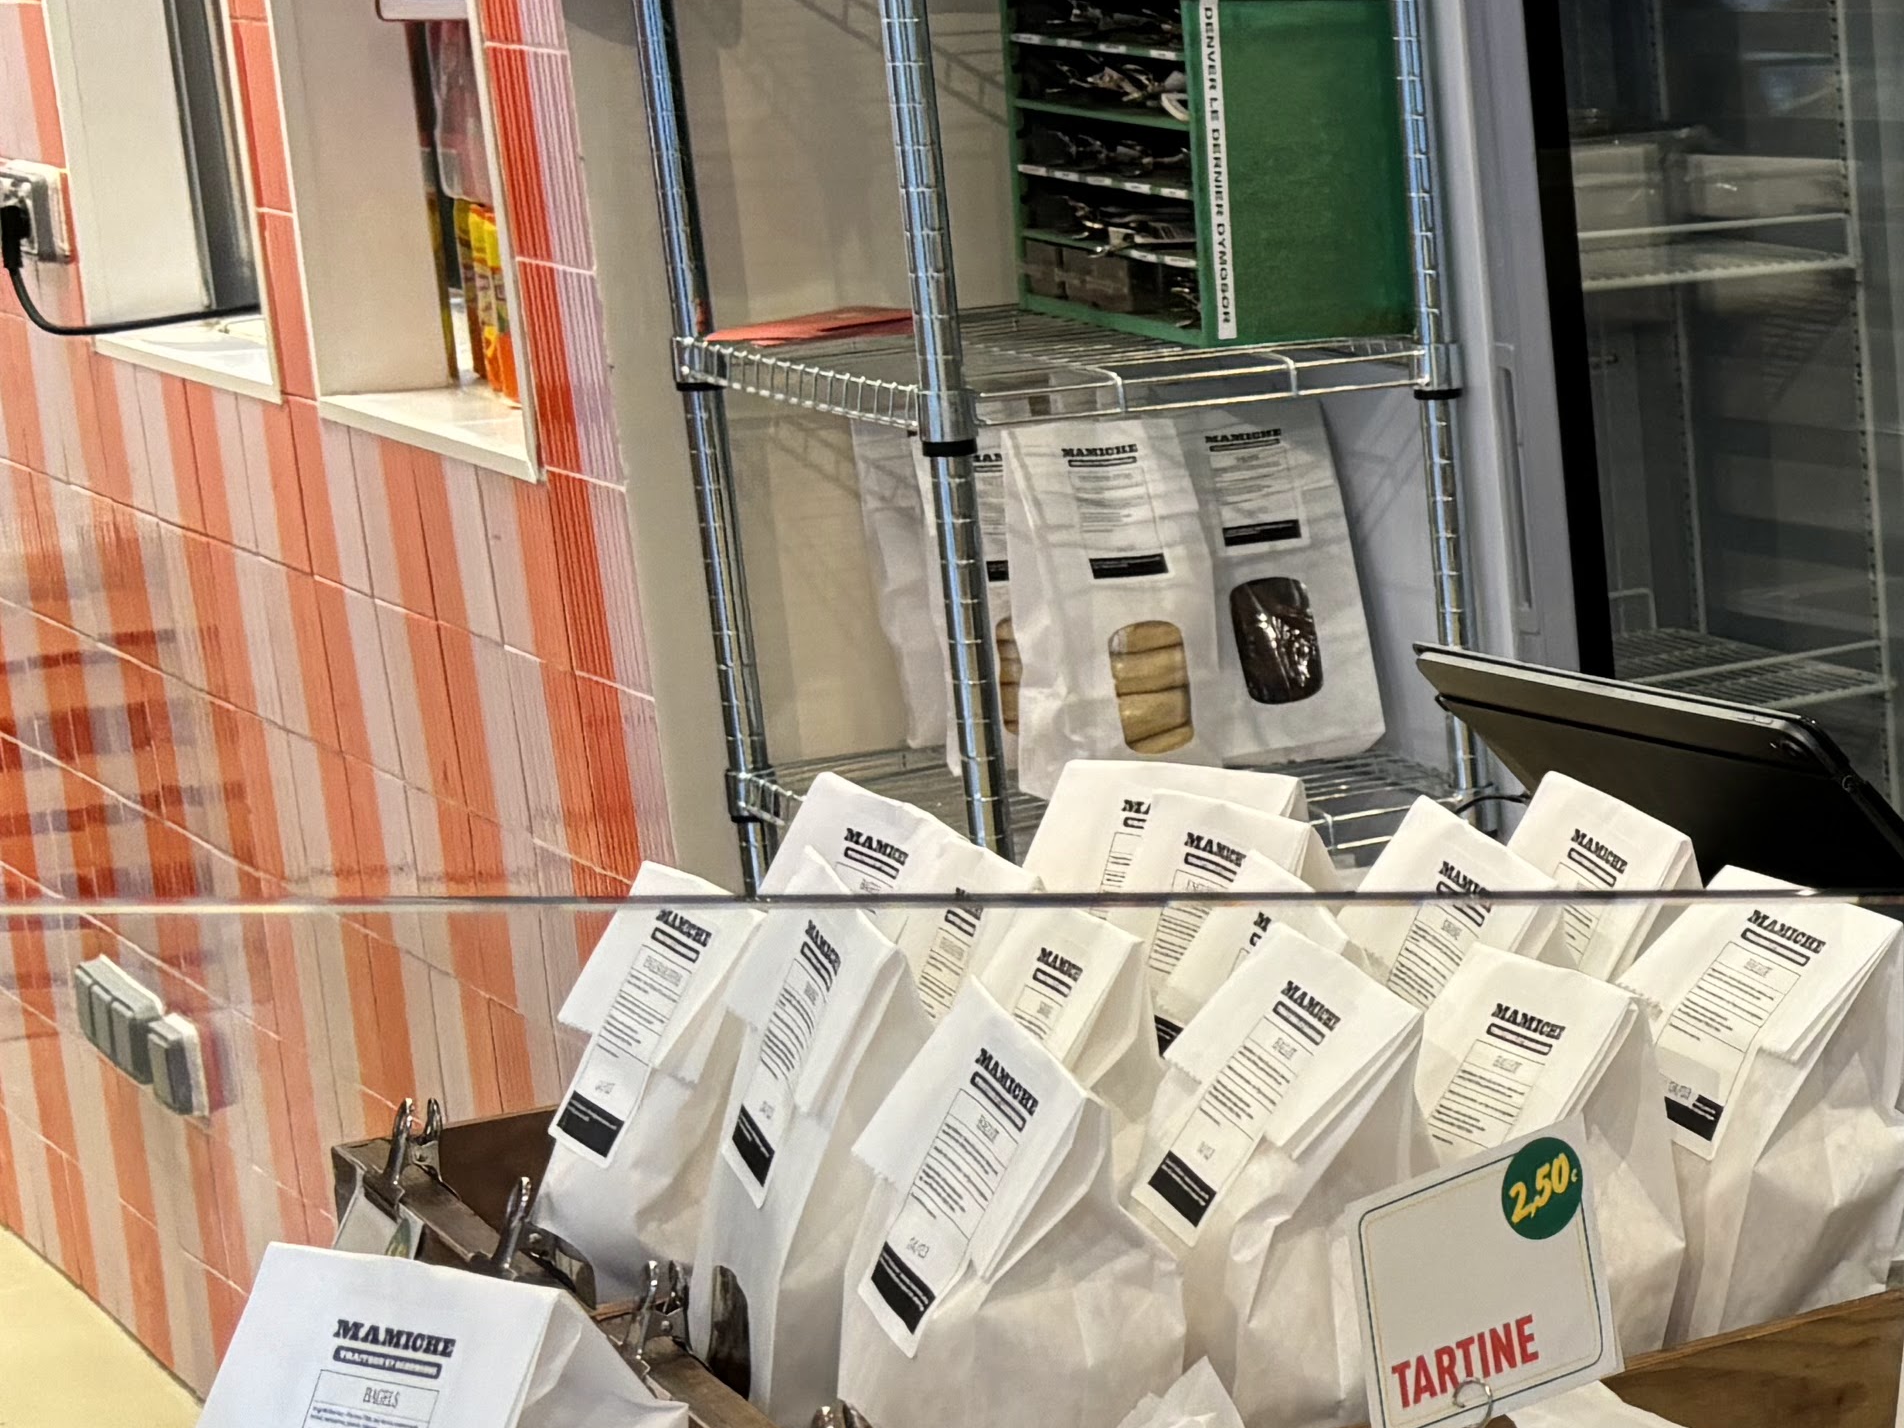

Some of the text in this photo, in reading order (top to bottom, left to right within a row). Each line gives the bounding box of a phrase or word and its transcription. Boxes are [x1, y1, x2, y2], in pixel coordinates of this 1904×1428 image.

[1204, 7, 1218, 90] DENVER
[1209, 97, 1220, 121] LE
[1211, 129, 1225, 216] DERNIER
[1571, 828, 1628, 874] MAMICHE
[1747, 909, 1826, 954] MAMICHE
[1280, 980, 1341, 1032] MAMICHE
[975, 1048, 1039, 1117] MAMICHE
[333, 1319, 456, 1359] MAMICHE
[1391, 1314, 1540, 1409] TARTINE
